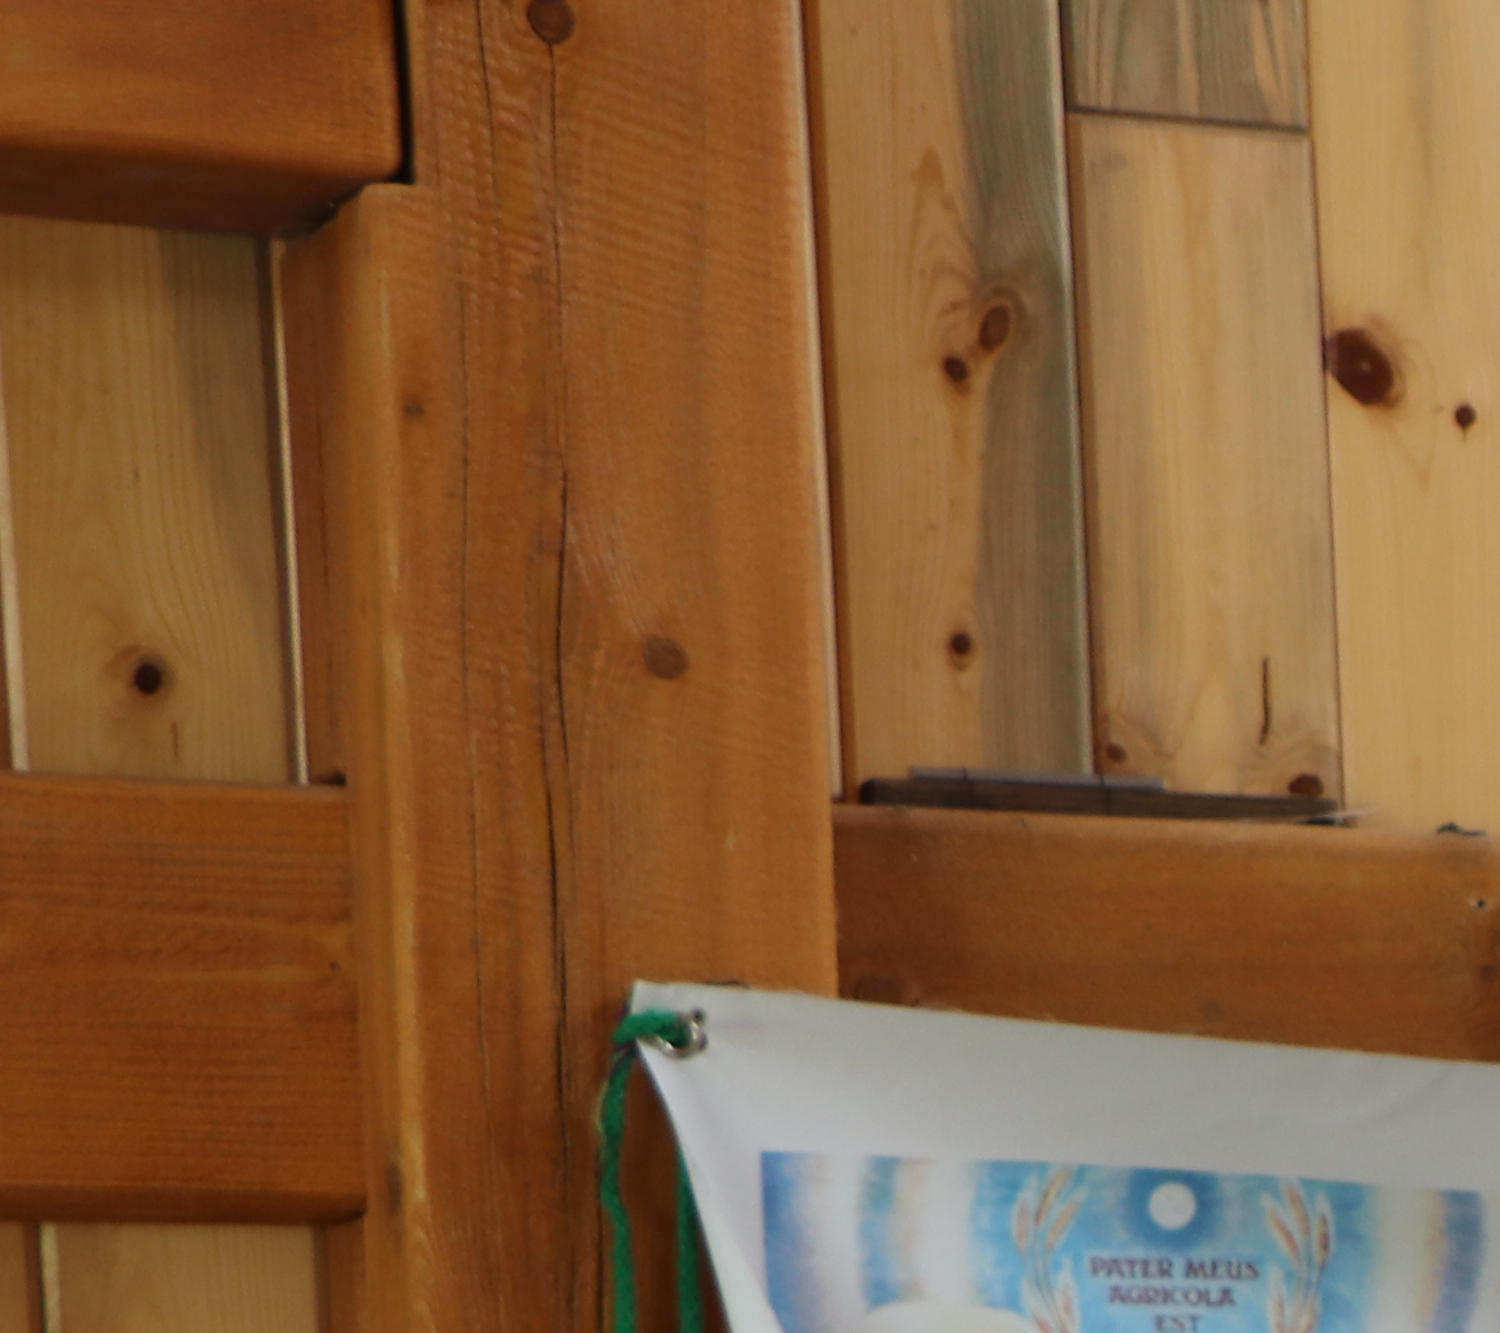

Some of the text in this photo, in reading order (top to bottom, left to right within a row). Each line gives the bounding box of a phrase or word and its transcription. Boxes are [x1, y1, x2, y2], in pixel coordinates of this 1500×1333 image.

[1090, 1256, 1259, 1280] PATER MEUS
[1109, 1286, 1234, 1306] AGRICOLA
[1156, 1315, 1199, 1333] EST
